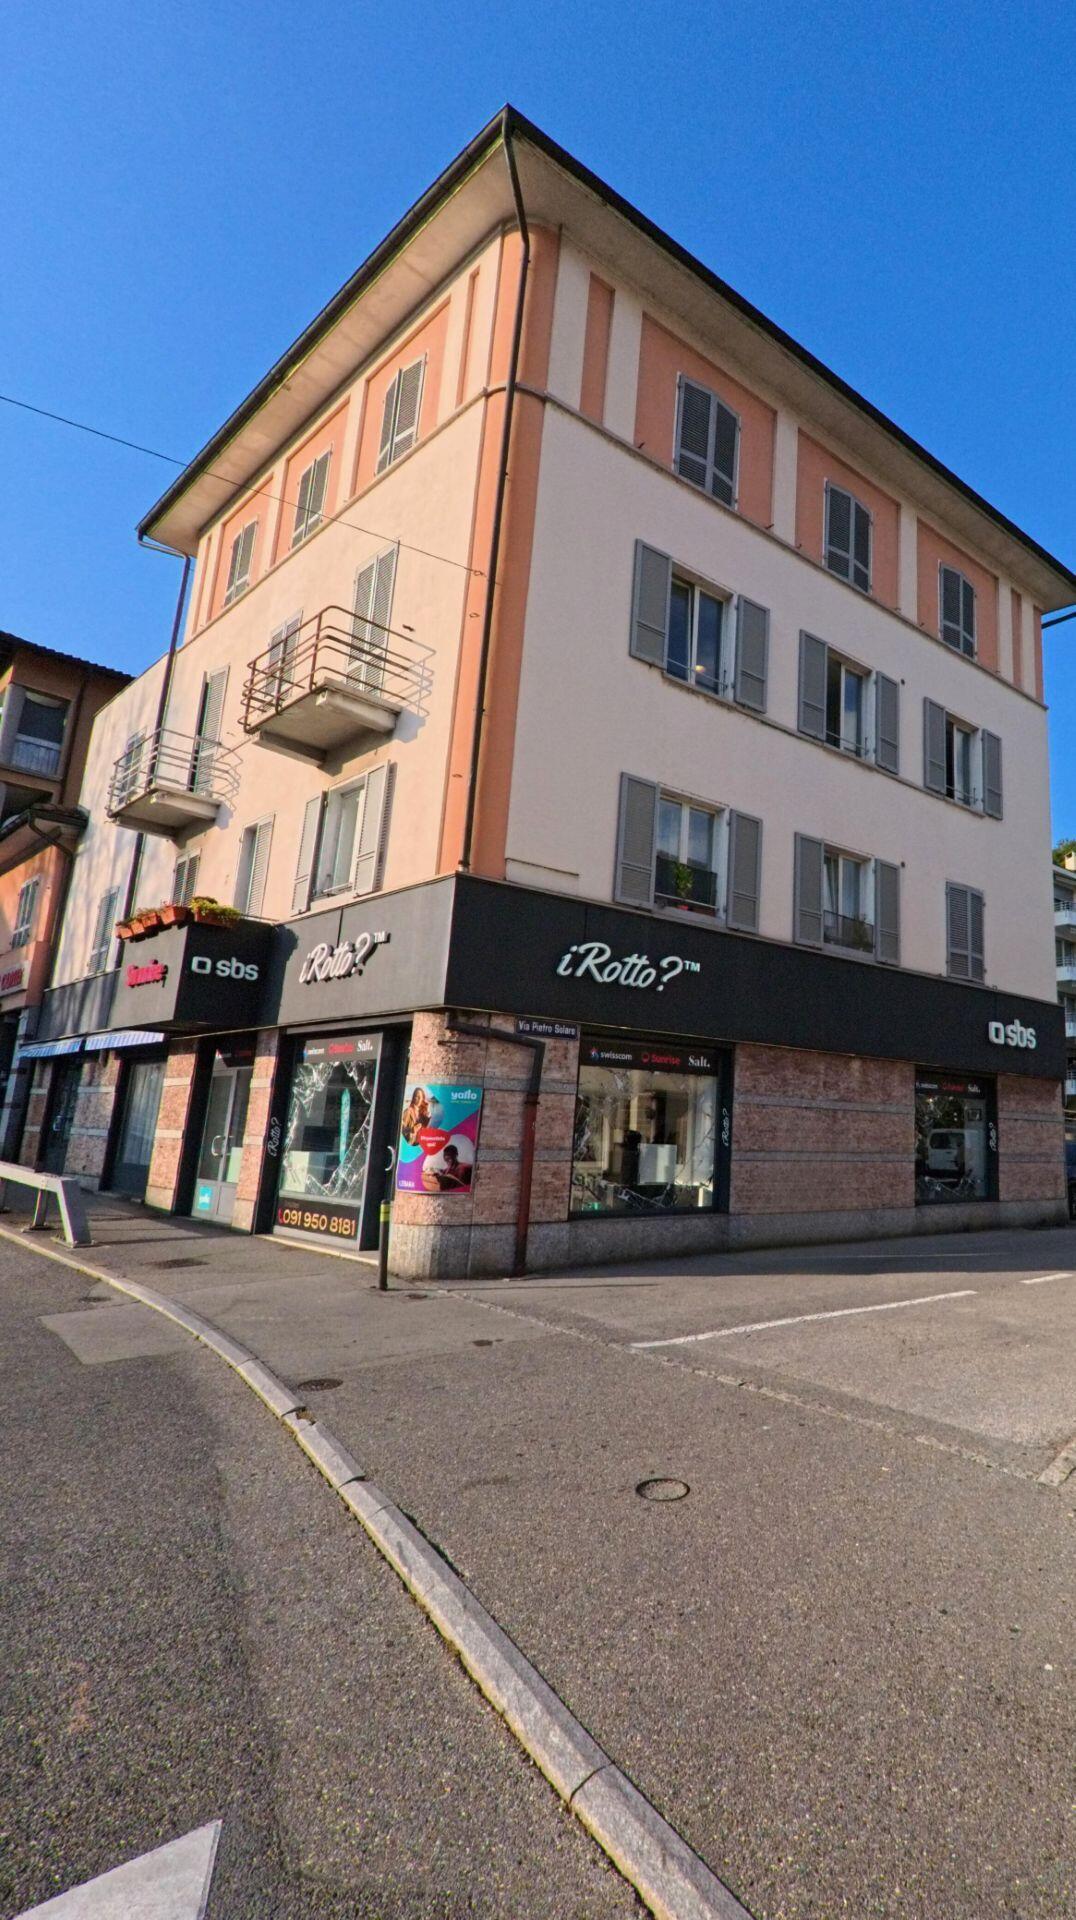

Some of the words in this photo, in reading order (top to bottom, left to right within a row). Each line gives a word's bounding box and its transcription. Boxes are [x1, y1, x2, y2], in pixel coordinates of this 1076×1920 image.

[215, 957, 259, 981] sbs
[518, 1020, 530, 1031] Via
[532, 1022, 553, 1033] Pietro
[1005, 1018, 1037, 1049] sbs
[600, 1050, 633, 1061] swisscom
[651, 1053, 681, 1065] Sunrise
[451, 1089, 477, 1100] yallo
[282, 1208, 302, 1227] 091
[304, 1211, 328, 1230] 950
[329, 1216, 356, 1237] 8181
